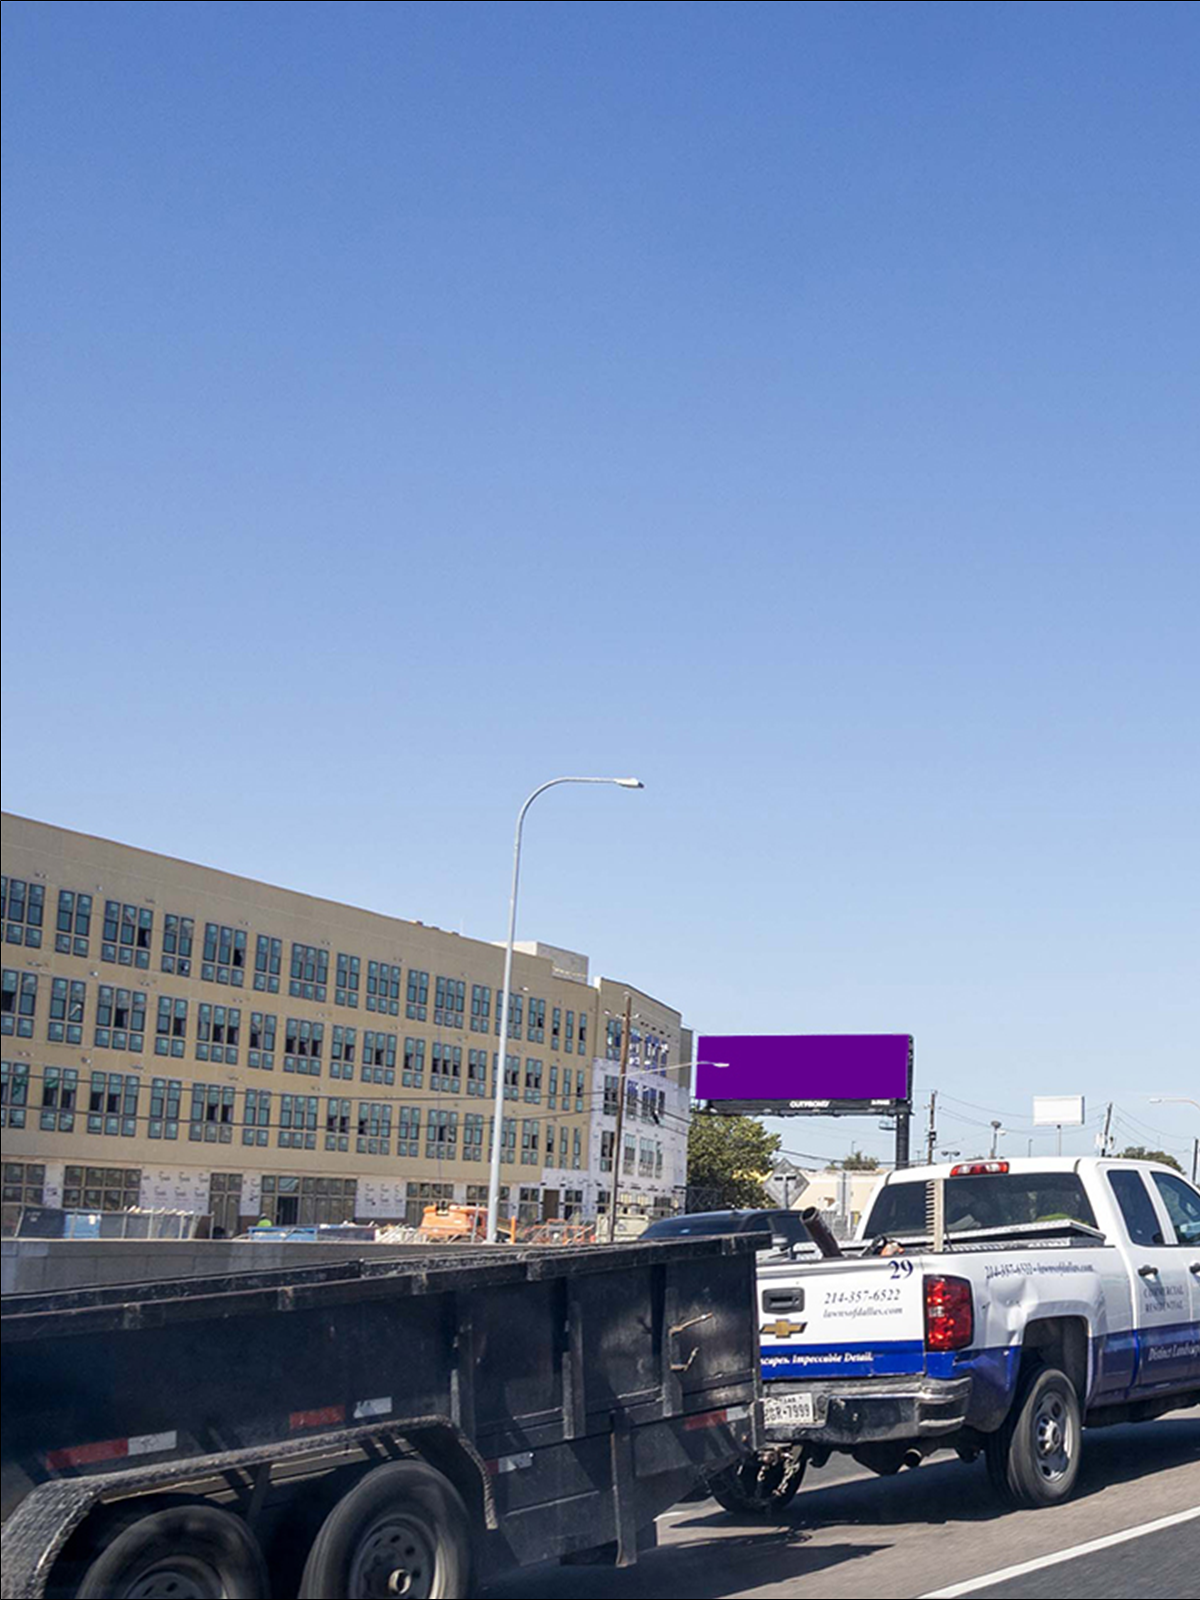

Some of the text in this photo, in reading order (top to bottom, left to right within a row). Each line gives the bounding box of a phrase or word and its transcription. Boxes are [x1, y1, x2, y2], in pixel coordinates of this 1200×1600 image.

[889, 1259, 914, 1279] 29
[824, 1289, 901, 1304] 214-357-6522
[823, 1306, 903, 1319] lawnsofdallas.com
[793, 1354, 842, 1366] Impeccable
[844, 1352, 874, 1363] Detail.
